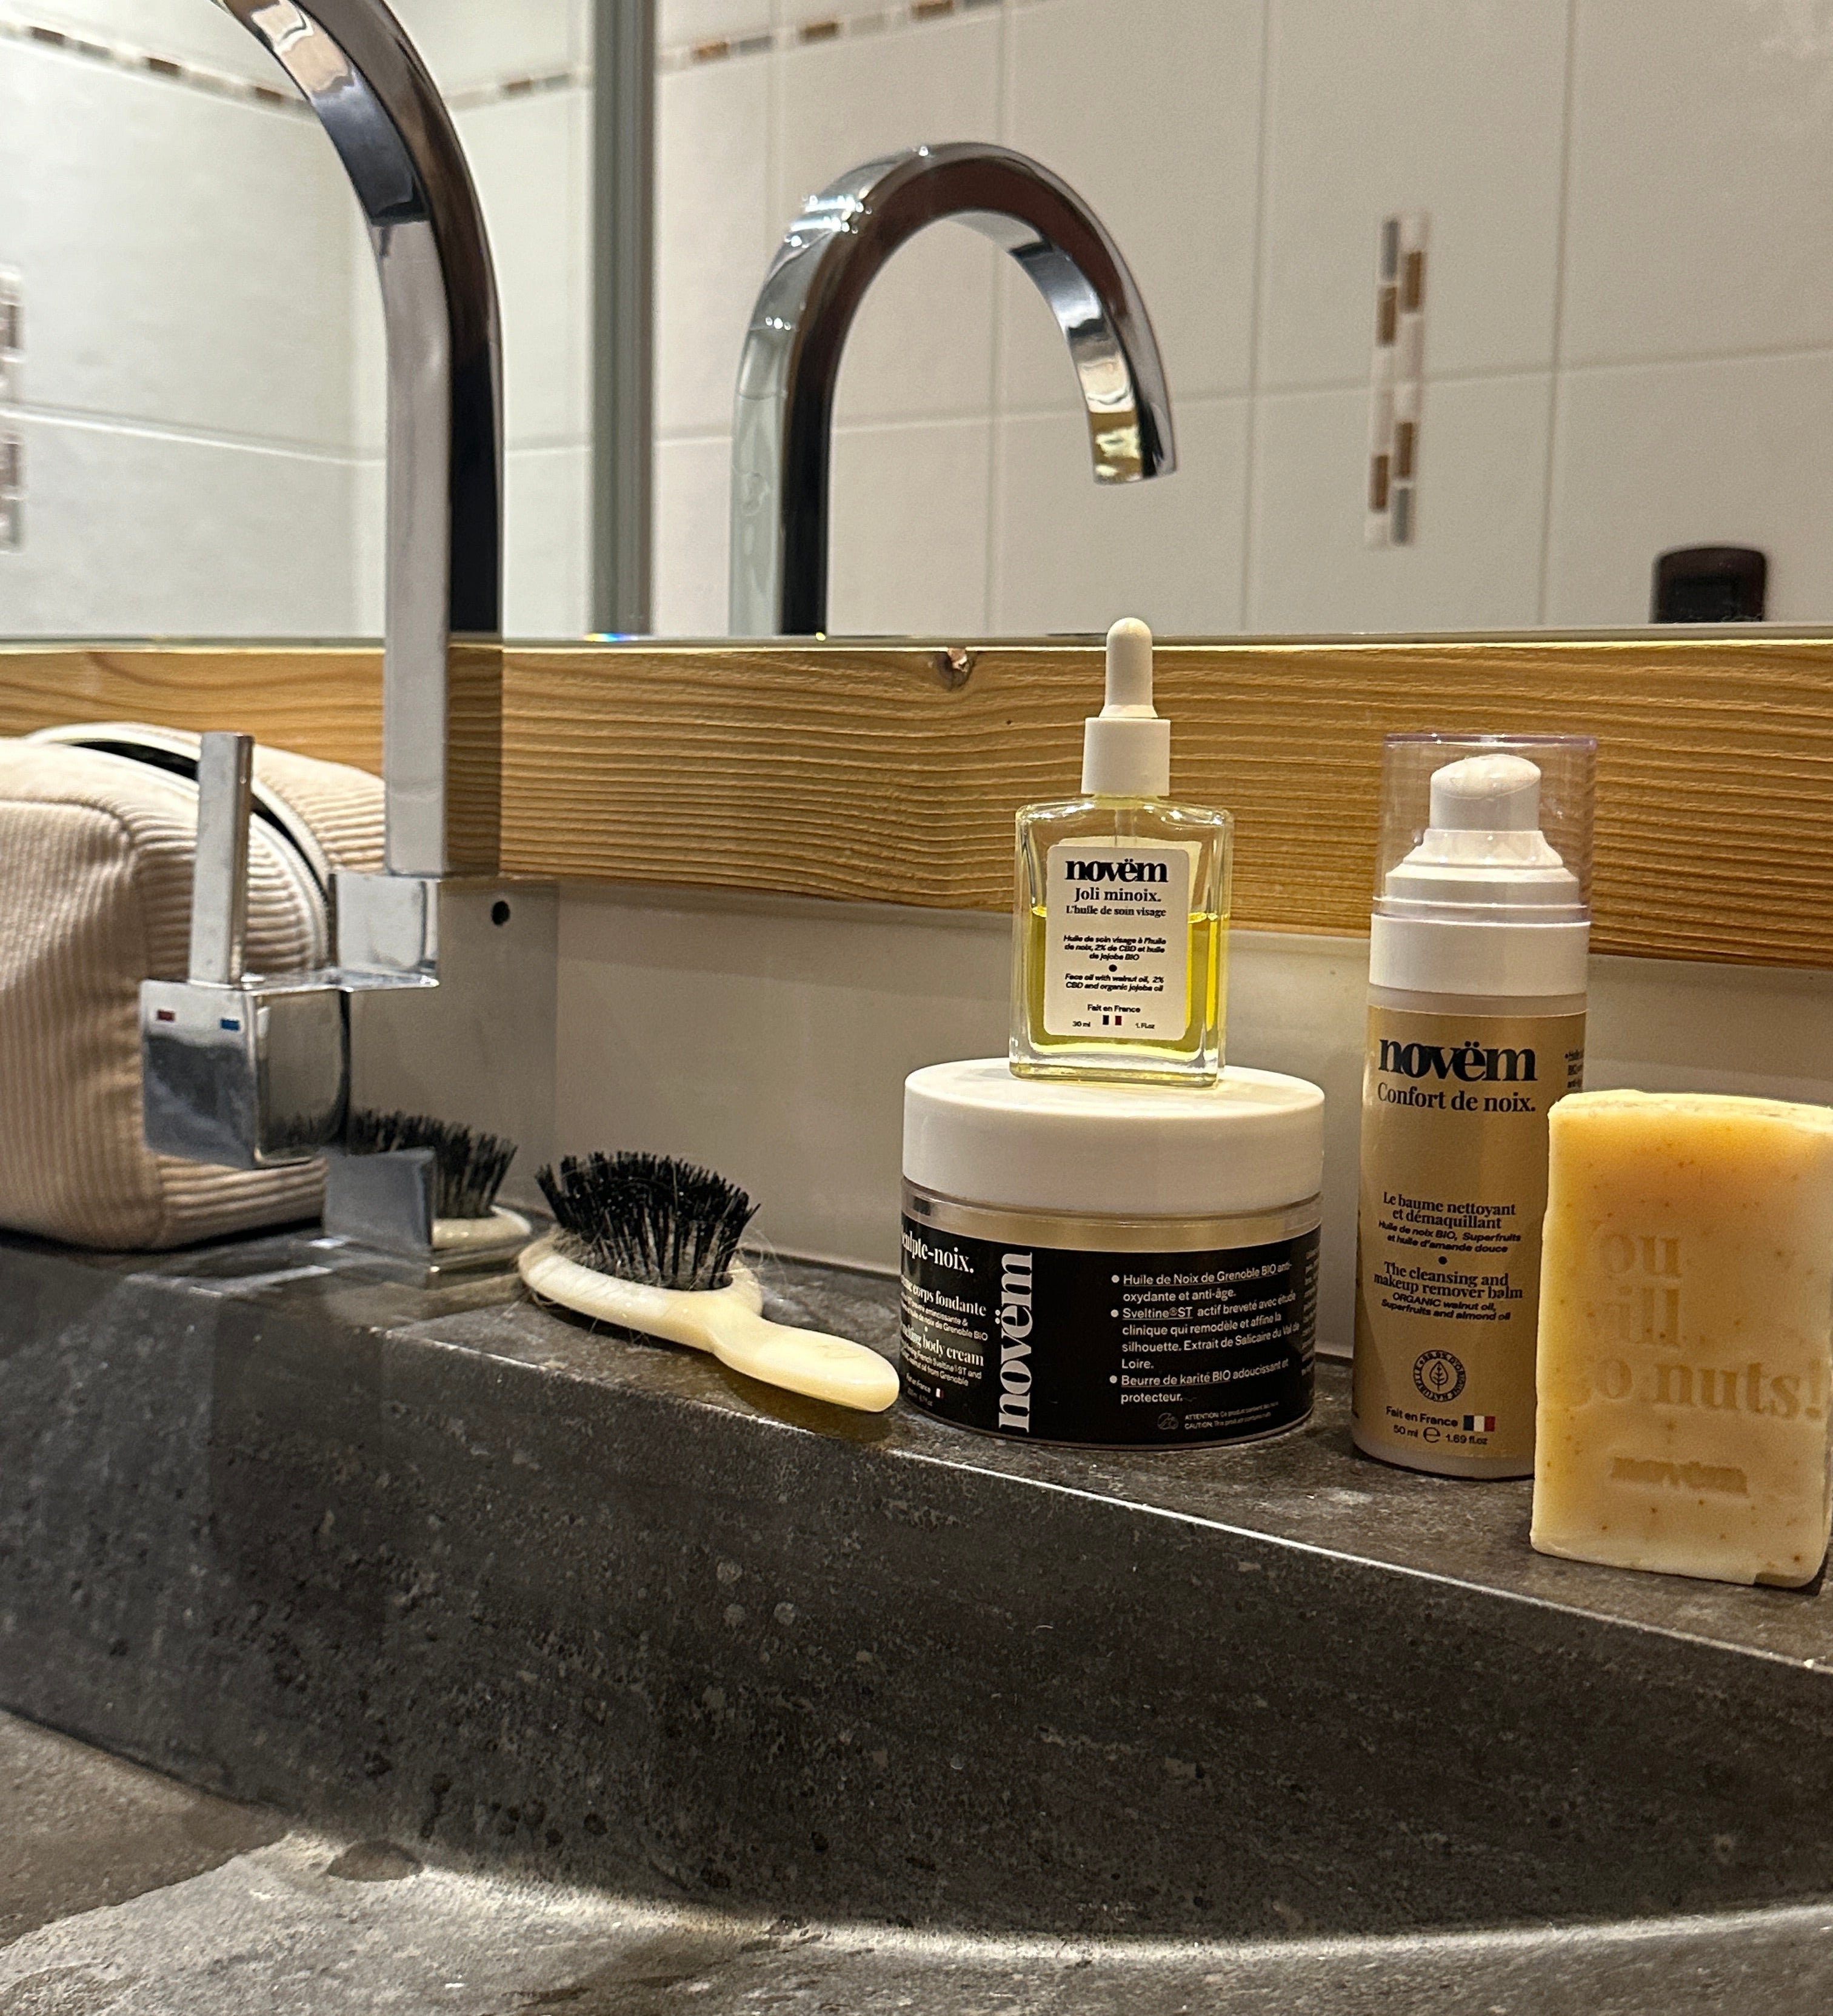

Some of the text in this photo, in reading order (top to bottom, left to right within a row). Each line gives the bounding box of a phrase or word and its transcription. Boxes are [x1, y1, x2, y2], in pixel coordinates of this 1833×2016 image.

[1064, 858, 1169, 883] novëm
[1074, 887, 1161, 903] Joli minoix.
[1066, 906, 1167, 918] L'huile de soin visage
[1114, 1004, 1141, 1013] France
[1377, 1039, 1538, 1083] novëm
[1378, 1082, 1536, 1112] Confort de noix.
[1383, 1191, 1516, 1218] Le baume nettoyant
[1392, 1208, 1502, 1229] et démaquillant
[1378, 1220, 1521, 1243] Huile de noix BIO, Superfruits
[1397, 1235, 1418, 1247] huile
[1420, 1238, 1472, 1252] d'amande
[1475, 1244, 1508, 1253] douce
[1123, 1274, 1154, 1285] Huile
[1156, 1273, 1172, 1284] de
[1174, 1273, 1199, 1284] Noix
[1201, 1272, 1215, 1283] de
[1217, 1267, 1260, 1281] Grenoble
[1261, 1264, 1277, 1276] BIO
[1384, 1261, 1509, 1288] The cleansing and
[1374, 1273, 1523, 1299] makeup remover balm
[935, 1290, 987, 1317] fondante
[1123, 1291, 1177, 1304] oxydante
[1178, 1291, 1190, 1301] et
[1197, 1304, 1221, 1317] actif
[1223, 1299, 1257, 1314] breveté
[1392, 1292, 1497, 1312] ORGANIC walnut oil,
[1381, 1298, 1511, 1321] Superfruits and almond oil
[1122, 1324, 1168, 1338] clinique
[1170, 1323, 1188, 1337] qui
[1190, 1320, 1238, 1334] remodèle
[1240, 1319, 1249, 1329] et
[1250, 1315, 1274, 1327] affine
[922, 1333, 945, 1358] body
[946, 1347, 984, 1366] cream
[995, 1252, 1033, 1433] novëm
[1121, 1341, 1182, 1352] silhouette.
[1184, 1338, 1219, 1350] Extrait
[1220, 1337, 1234, 1348] de
[1121, 1358, 1154, 1369] Loire.
[1121, 1375, 1161, 1386] Beurre
[1163, 1374, 1178, 1385] de
[1180, 1371, 1210, 1384] karité
[1212, 1369, 1231, 1382] BIO
[1121, 1392, 1183, 1405] protecteur.
[1654, 1358, 1823, 1420] nuts!
[1386, 1405, 1458, 1427] Fait en France
[1394, 1424, 1406, 1435] 50
[1407, 1428, 1418, 1438] ml
[1445, 1433, 1467, 1444] 1.69
